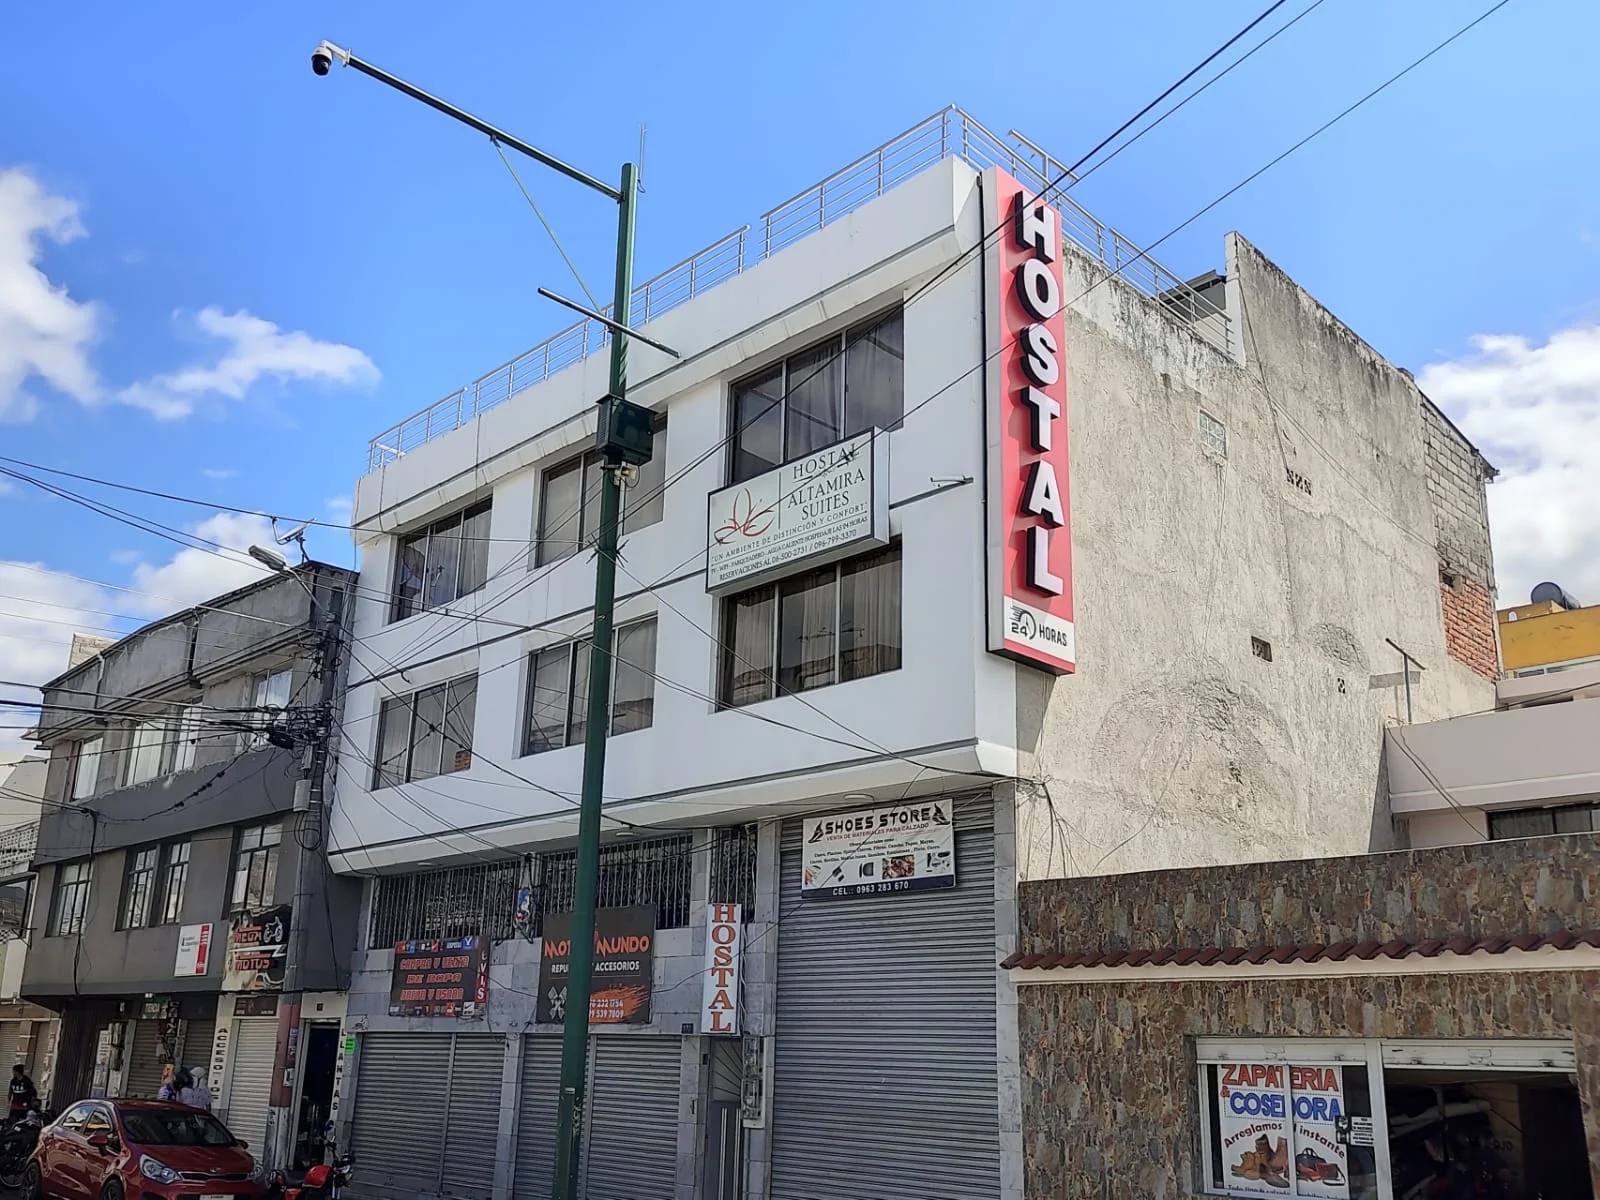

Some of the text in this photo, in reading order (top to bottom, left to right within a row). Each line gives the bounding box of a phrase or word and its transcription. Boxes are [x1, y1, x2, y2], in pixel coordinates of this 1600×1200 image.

[1014, 190, 1064, 598] HOSTAL
[793, 443, 860, 480] HOSTAL
[787, 468, 865, 509] ALTAMIRA
[801, 491, 849, 521] SUITES
[725, 541, 760, 555] AMBIENTE
[762, 536, 771, 545] DE
[719, 561, 763, 580] RESERVACIONES
[1011, 622, 1068, 647] 24 HORAS
[825, 807, 931, 835] SHOES STORE
[901, 822, 930, 831] CALZADO
[856, 884, 875, 894] 0963
[877, 882, 892, 892] 283
[894, 880, 909, 890] 670
[596, 935, 650, 957] MUNDO
[595, 960, 640, 972] ACCESORIOS
[708, 903, 737, 1032] HOSTAL
[332, 1027, 346, 1111] LLANTAS
[1221, 1064, 1340, 1092] ZAPATERIA
[1224, 1122, 1283, 1149] Arreglamos
[1299, 1125, 1345, 1159] instante
